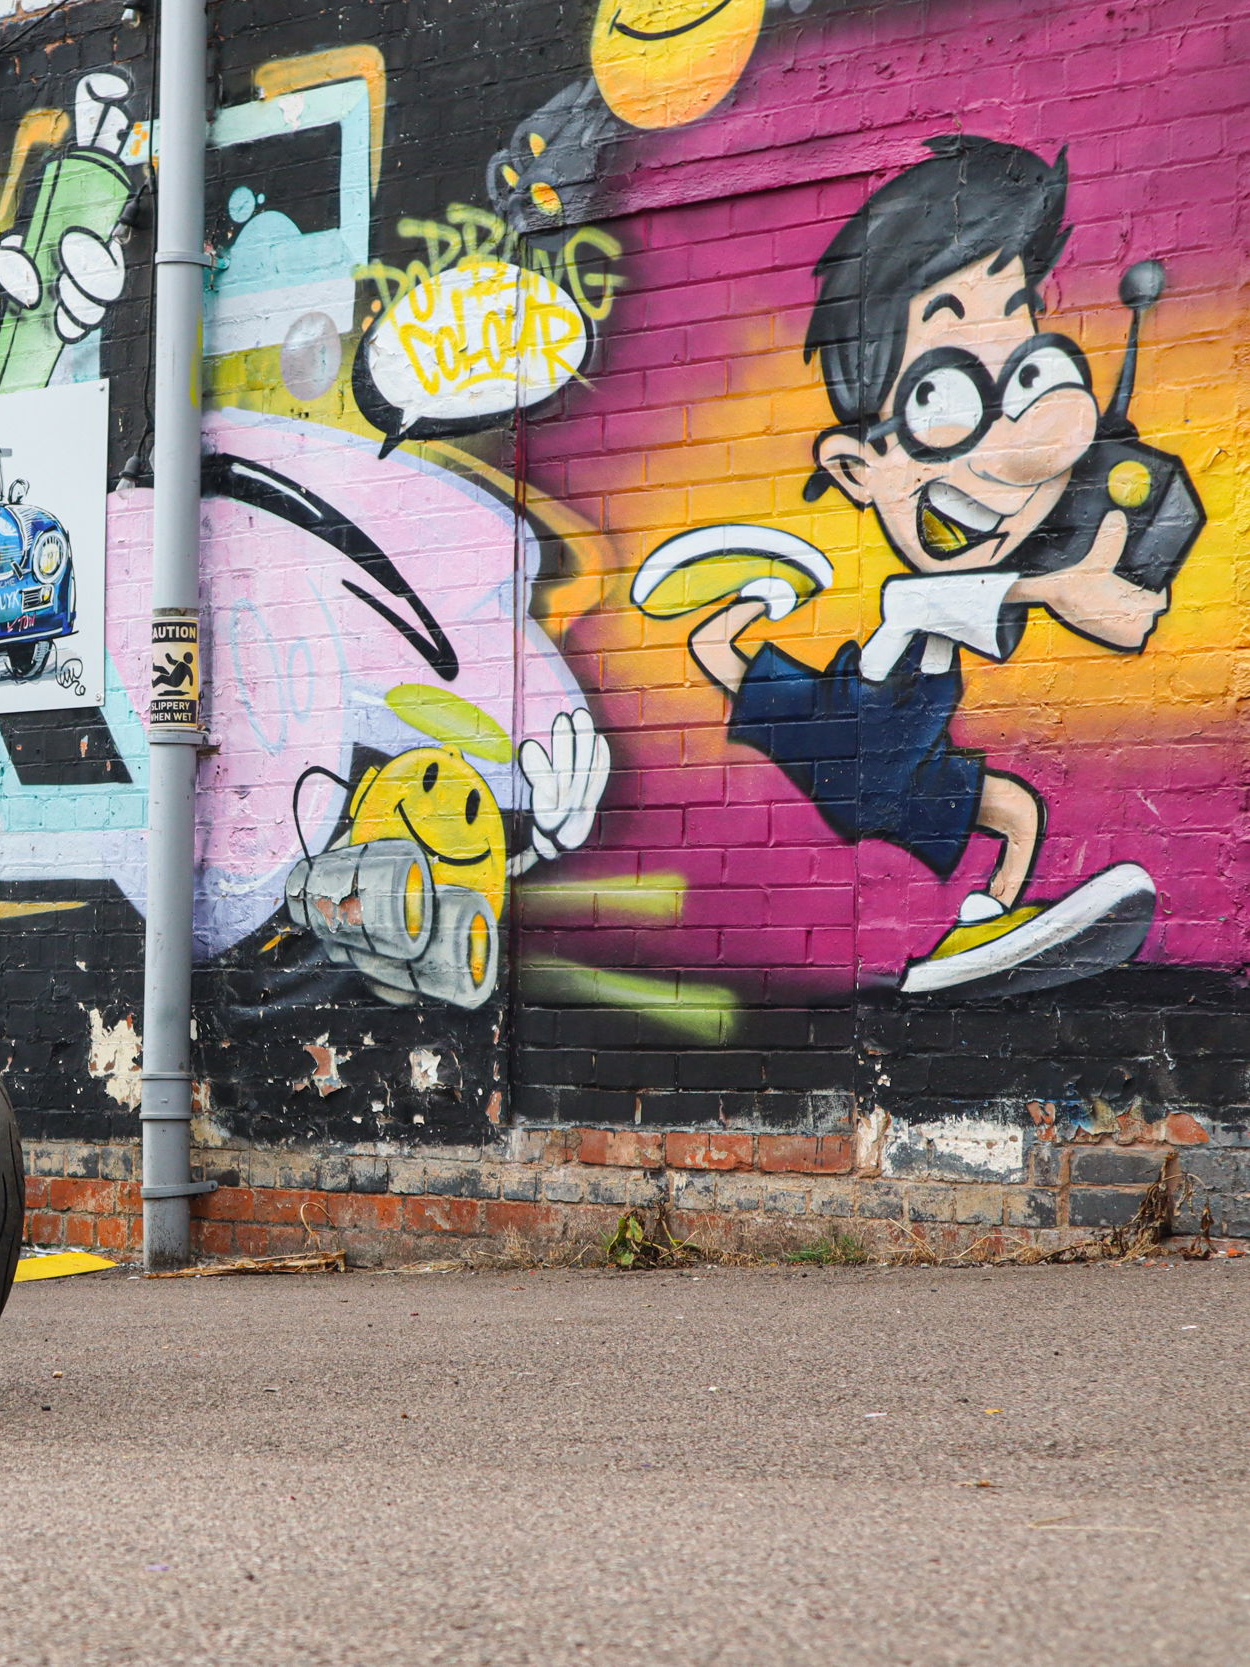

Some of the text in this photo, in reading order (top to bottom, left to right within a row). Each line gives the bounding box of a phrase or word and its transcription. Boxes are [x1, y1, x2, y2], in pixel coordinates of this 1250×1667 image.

[400, 294, 596, 395] COLOUR
[151, 626, 197, 639] AUTION
[151, 701, 190, 711] SLIPPERY
[173, 712, 192, 722] WET
